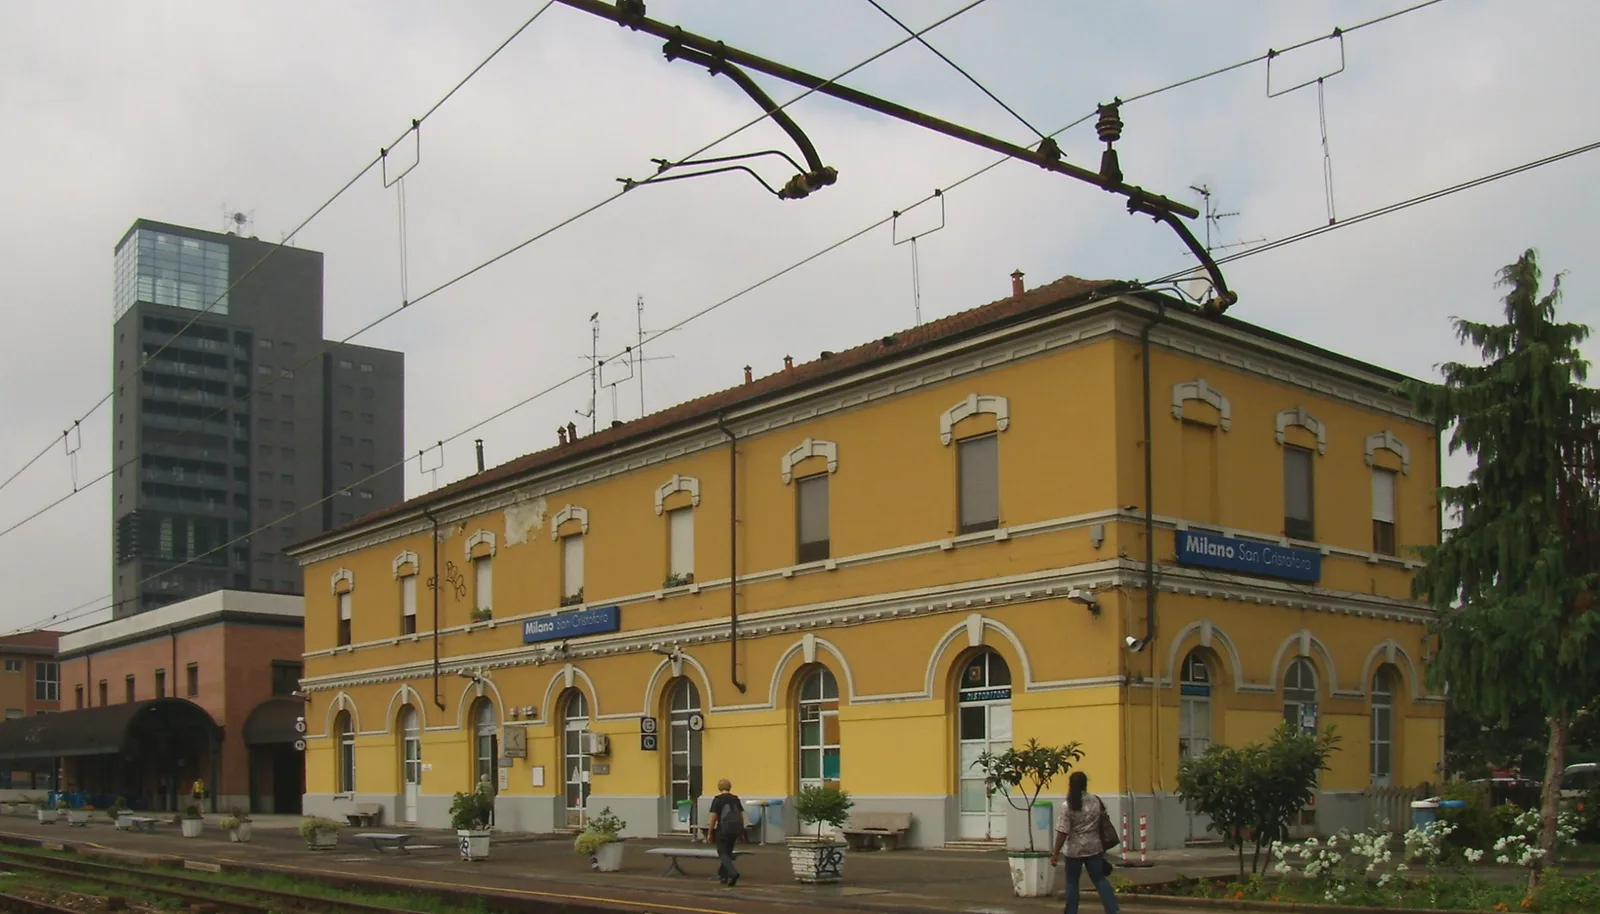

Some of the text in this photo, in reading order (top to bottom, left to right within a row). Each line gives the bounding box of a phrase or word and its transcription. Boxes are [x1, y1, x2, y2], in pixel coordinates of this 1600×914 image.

[1186, 535, 1235, 558] Milano
[1238, 543, 1258, 562] San
[525, 621, 554, 635] Milano
[556, 618, 570, 630] San
